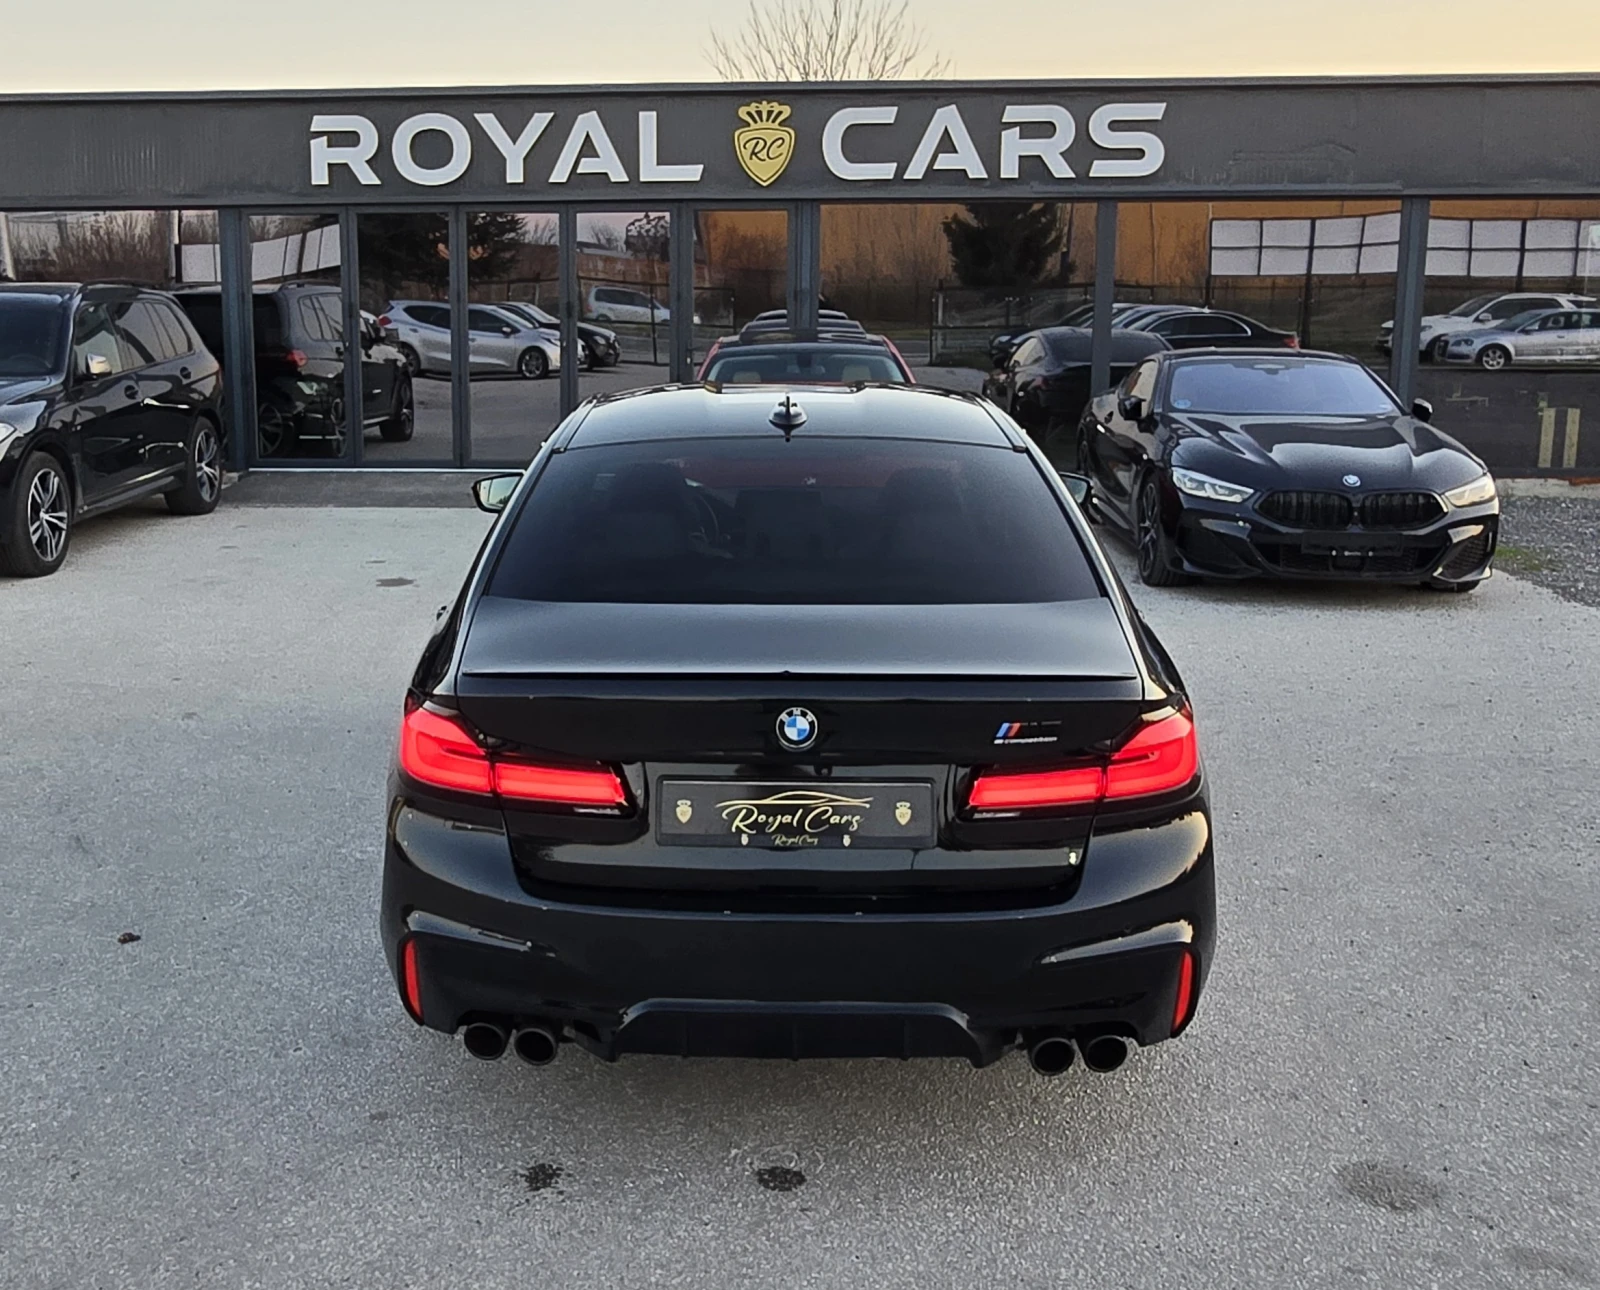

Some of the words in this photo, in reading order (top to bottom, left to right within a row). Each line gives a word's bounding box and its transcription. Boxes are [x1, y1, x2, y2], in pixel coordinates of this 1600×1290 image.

[309, 110, 704, 186] ROYAL
[822, 102, 1167, 180] CARS
[743, 136, 785, 162] RC
[721, 804, 803, 834] Royal
[804, 806, 864, 833] Cars
